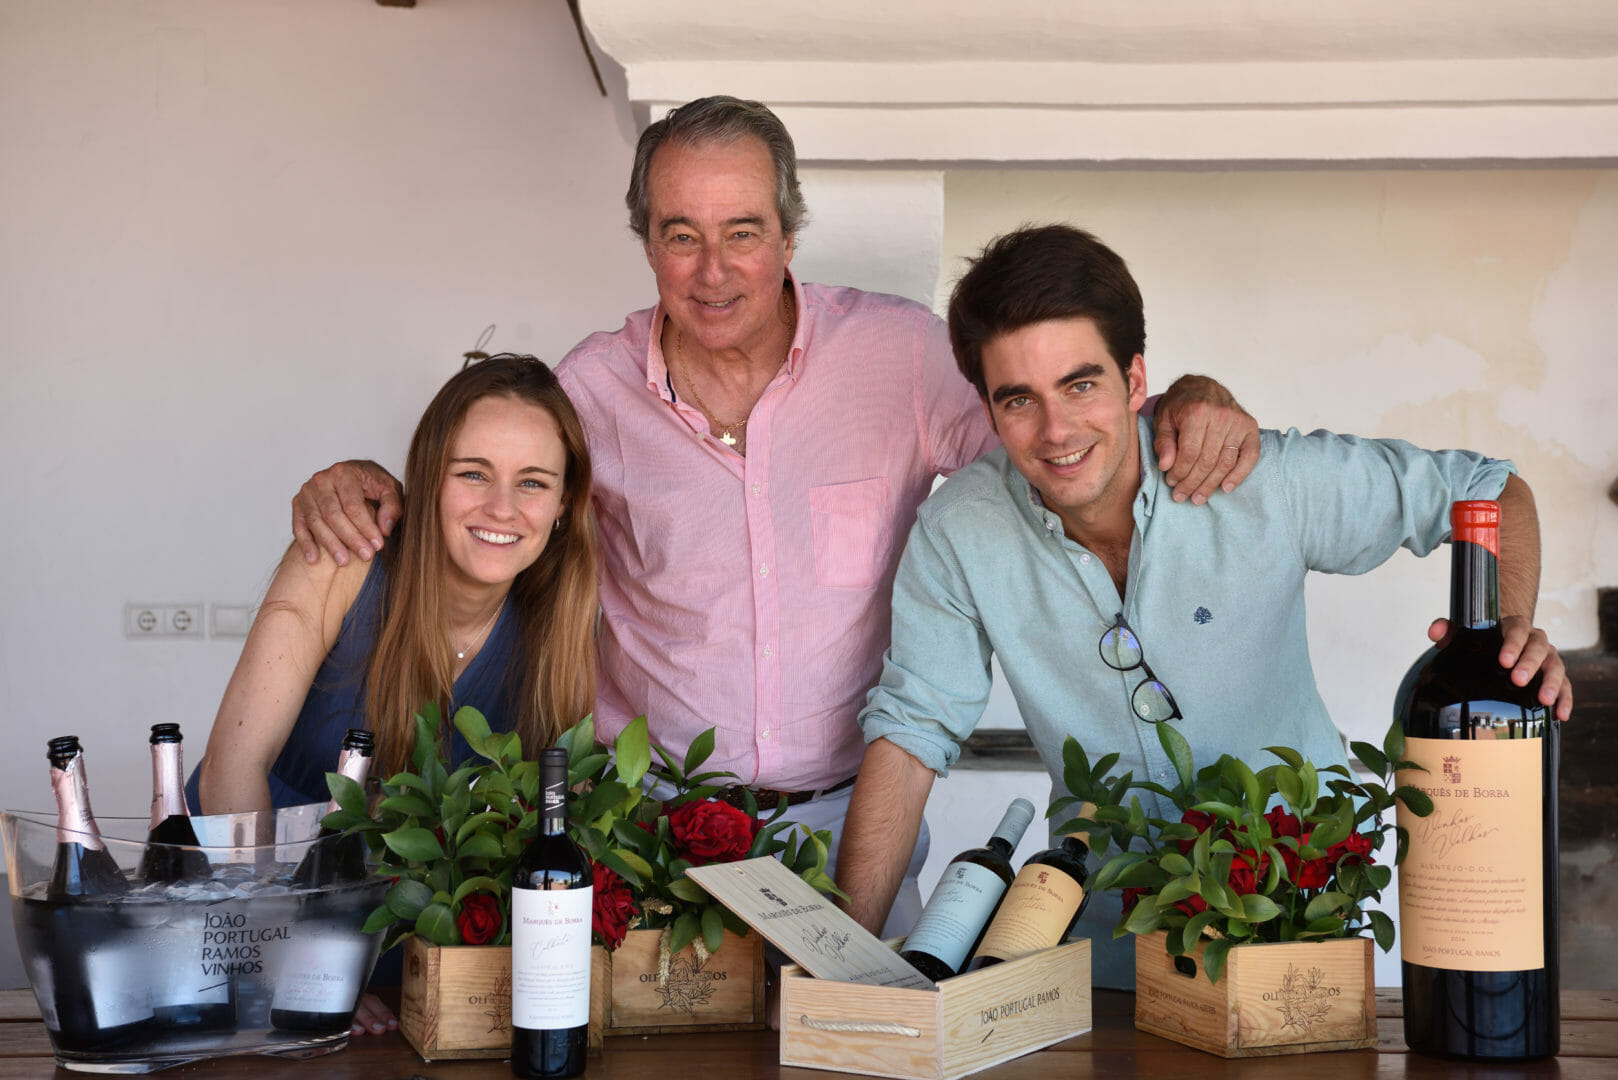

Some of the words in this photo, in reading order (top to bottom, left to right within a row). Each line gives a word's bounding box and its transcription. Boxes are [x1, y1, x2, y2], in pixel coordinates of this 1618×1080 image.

[1454, 788, 1470, 798] DE
[1472, 786, 1511, 799] BORBA
[203, 911, 246, 930] JOÃO
[203, 926, 292, 945] PORTUGAL
[202, 944, 261, 961] RAMOS
[201, 960, 263, 977] VINHOS
[1000, 995, 1036, 1019] PORTUGAL
